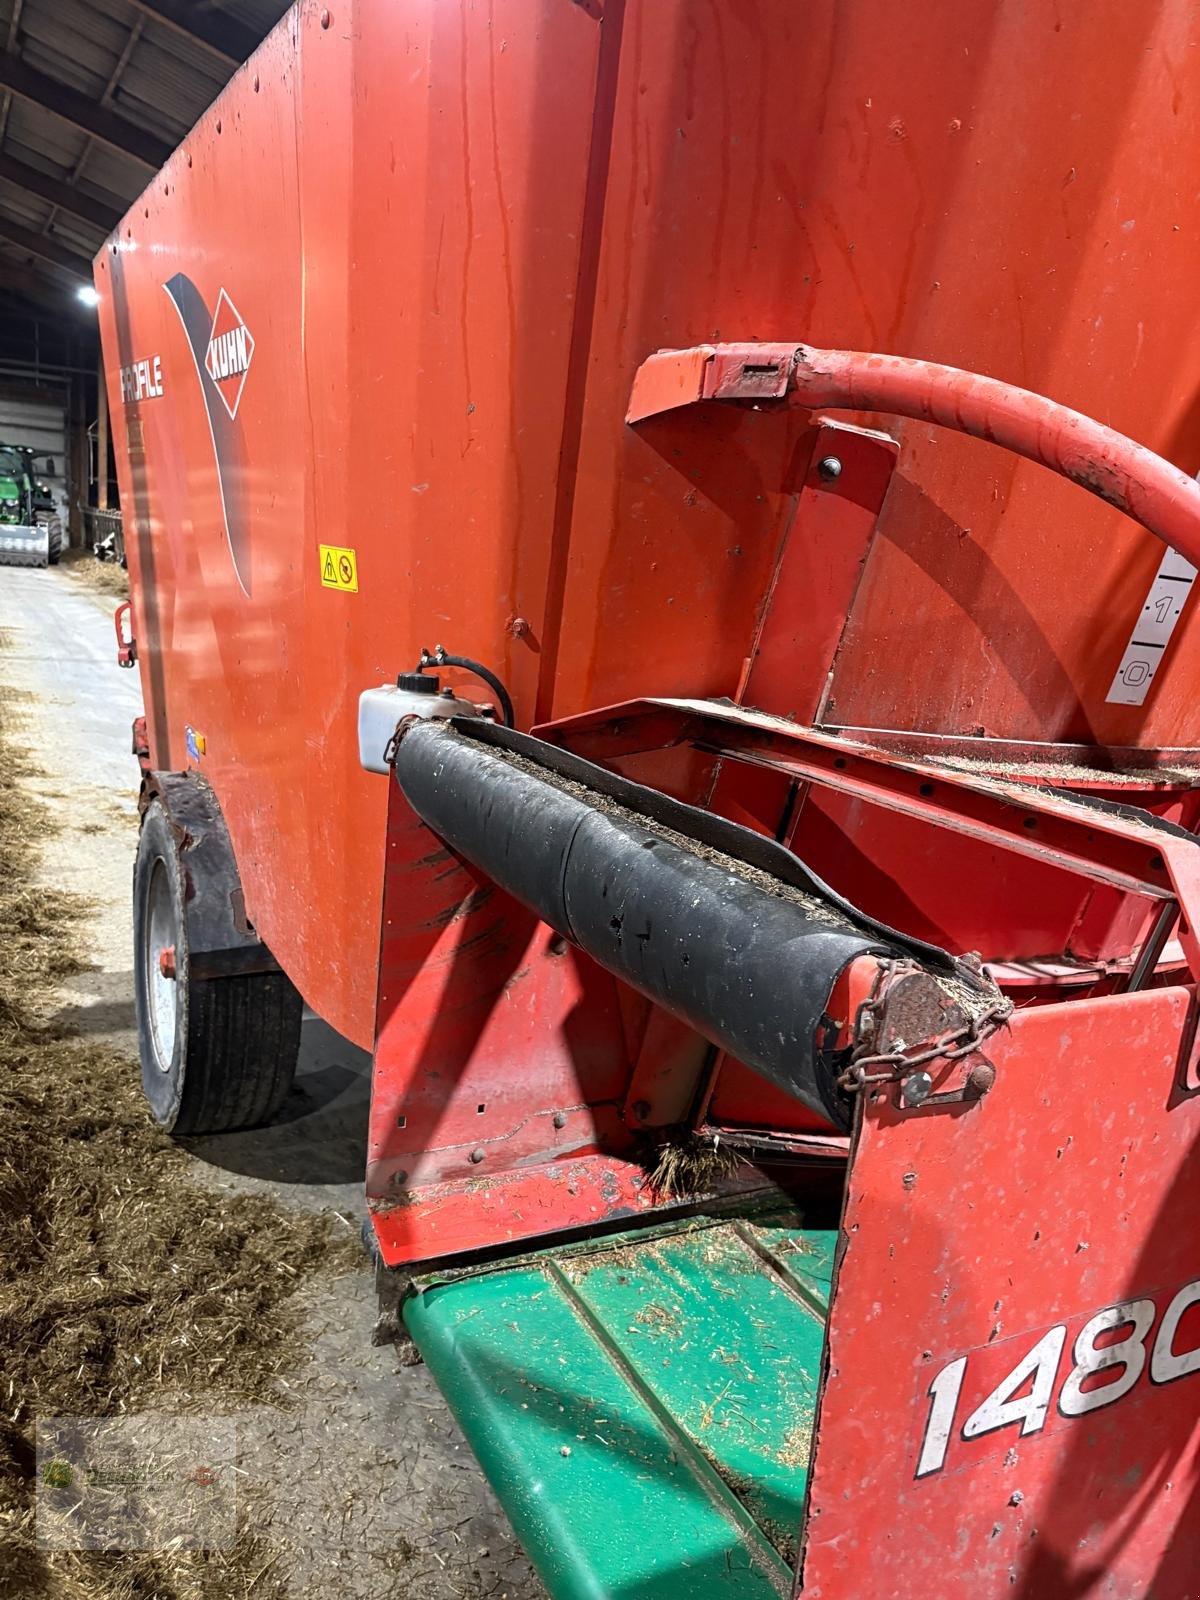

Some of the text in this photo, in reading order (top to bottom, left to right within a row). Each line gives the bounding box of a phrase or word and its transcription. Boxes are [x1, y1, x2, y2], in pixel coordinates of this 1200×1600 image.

[209, 325, 249, 380] KUHN
[120, 355, 163, 404] PROFILE
[1154, 595, 1174, 624] 1
